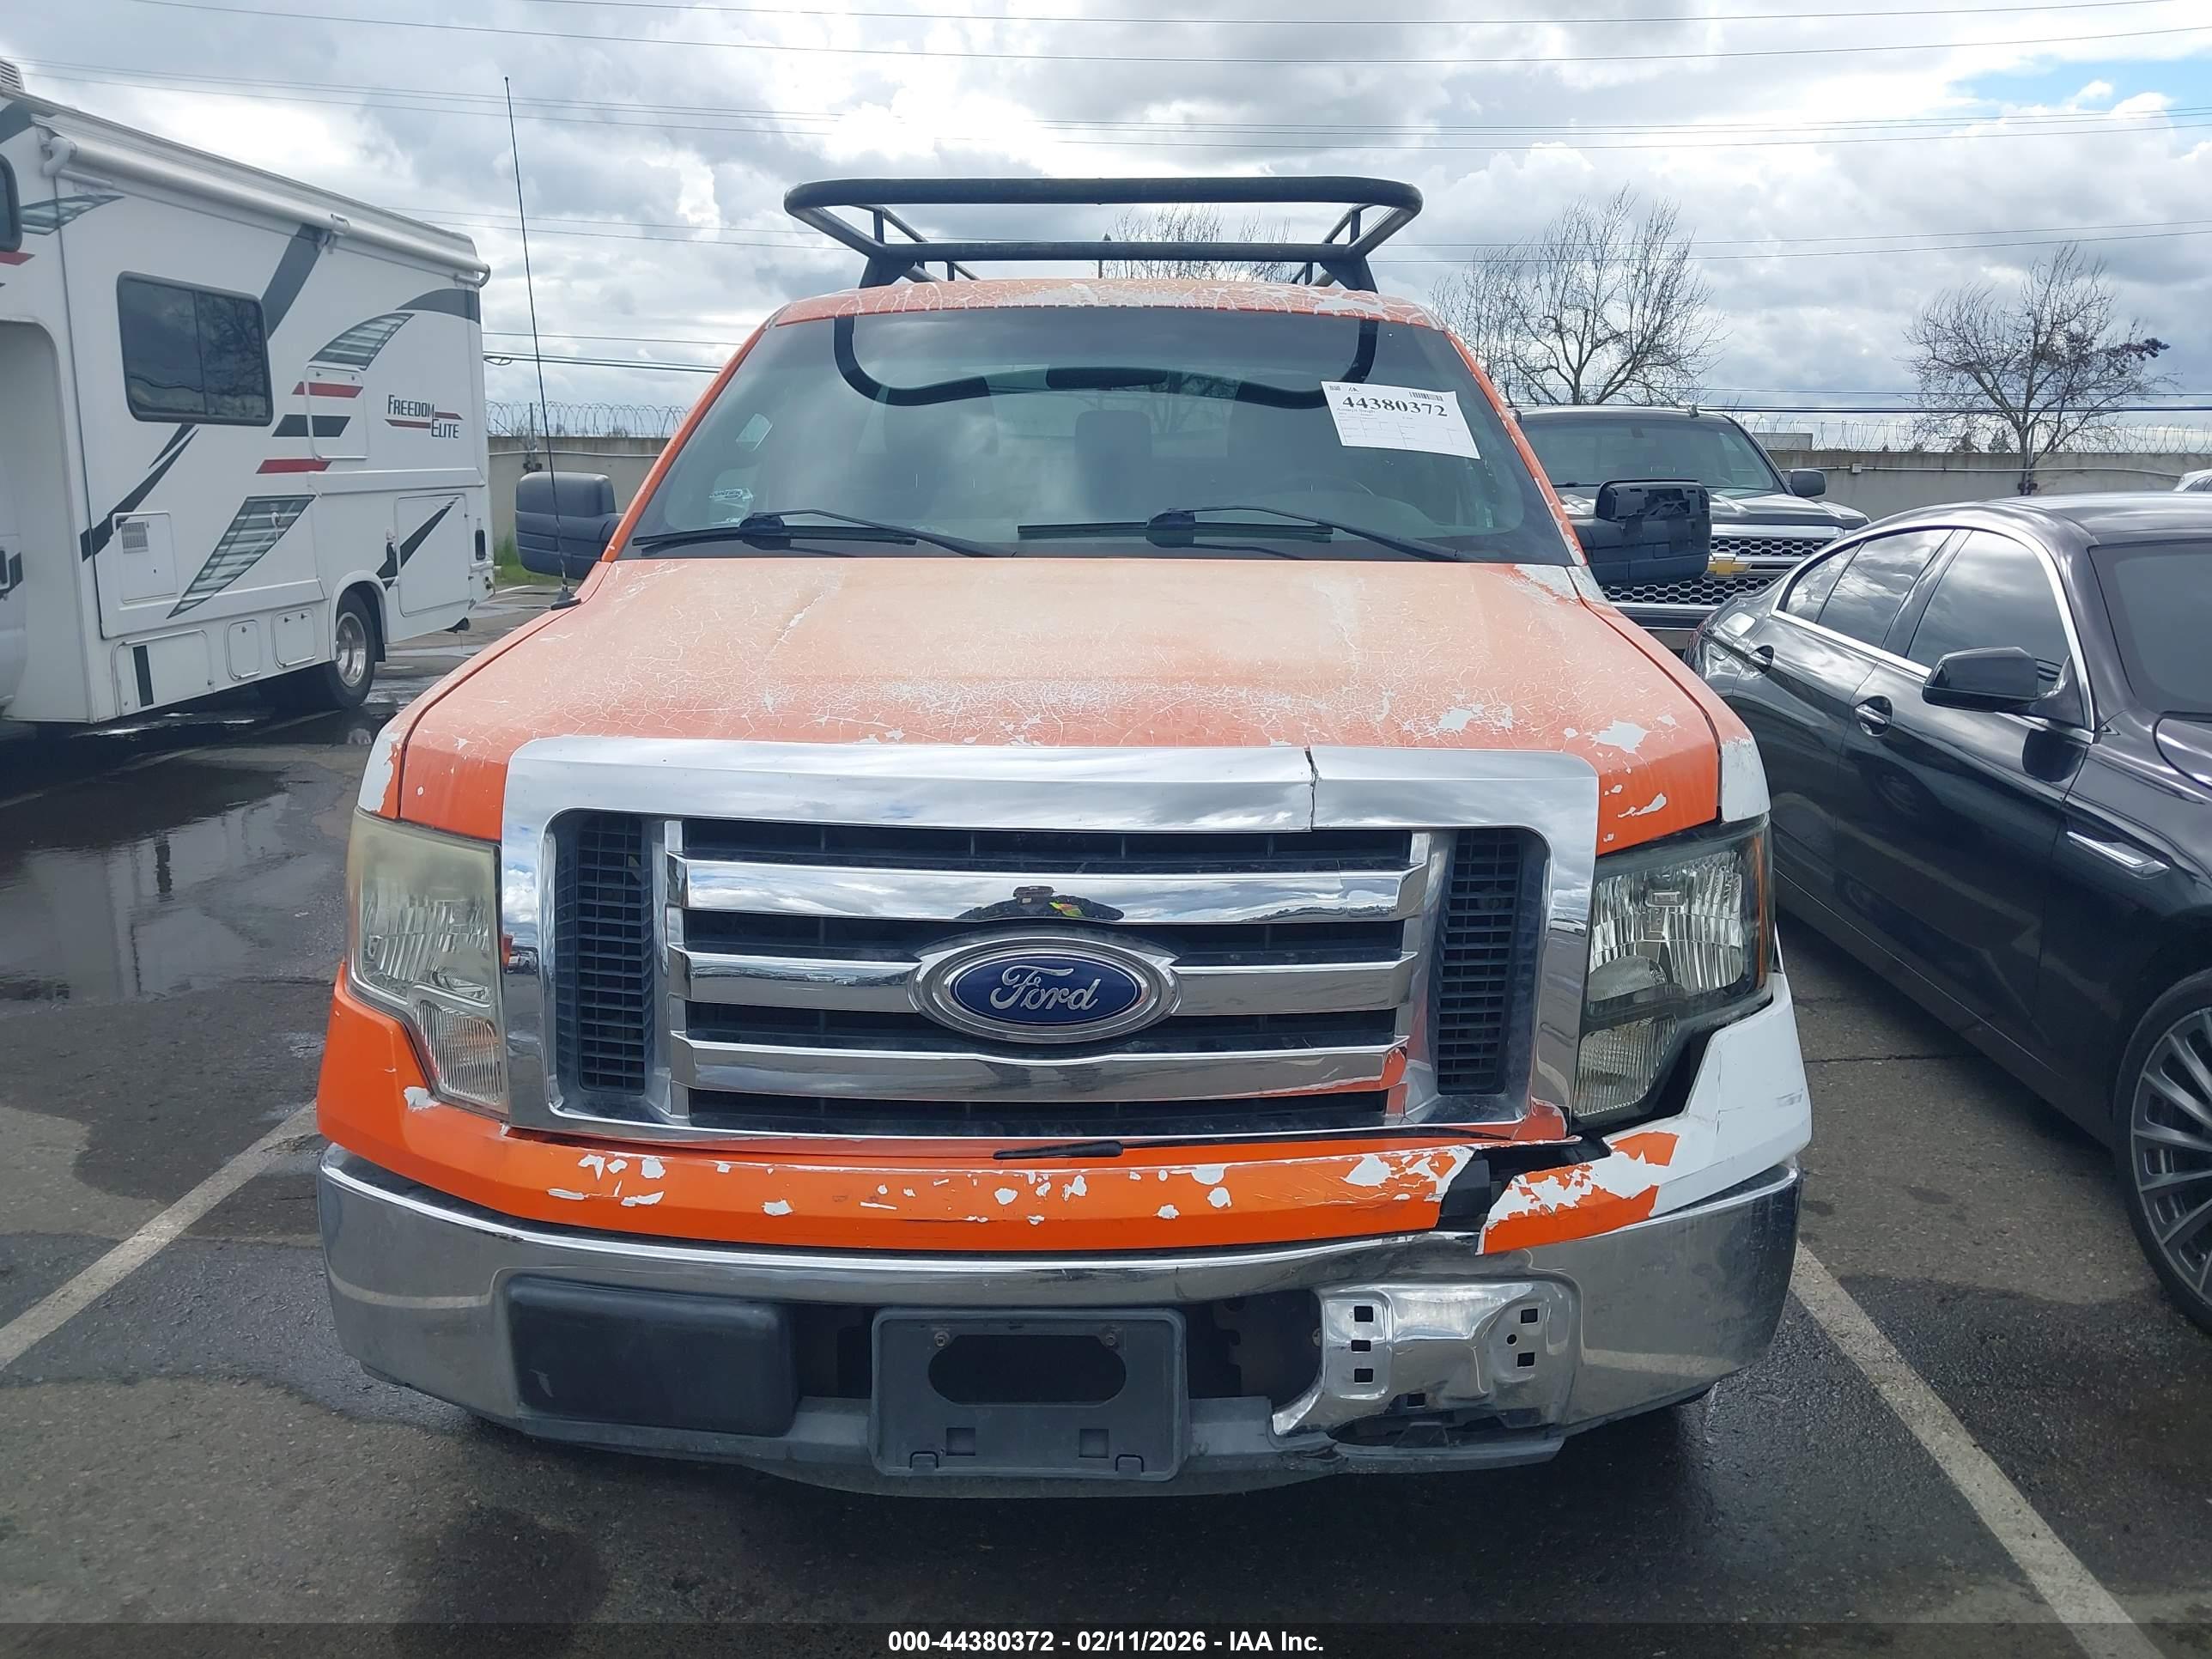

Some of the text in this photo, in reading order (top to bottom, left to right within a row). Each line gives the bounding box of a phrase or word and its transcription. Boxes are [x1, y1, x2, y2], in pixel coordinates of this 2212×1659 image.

[387, 394, 434, 418] FREEDOM
[1342, 396, 1448, 417] 44380372
[431, 418, 460, 439] ELITE
[989, 964, 1102, 1011] Ford
